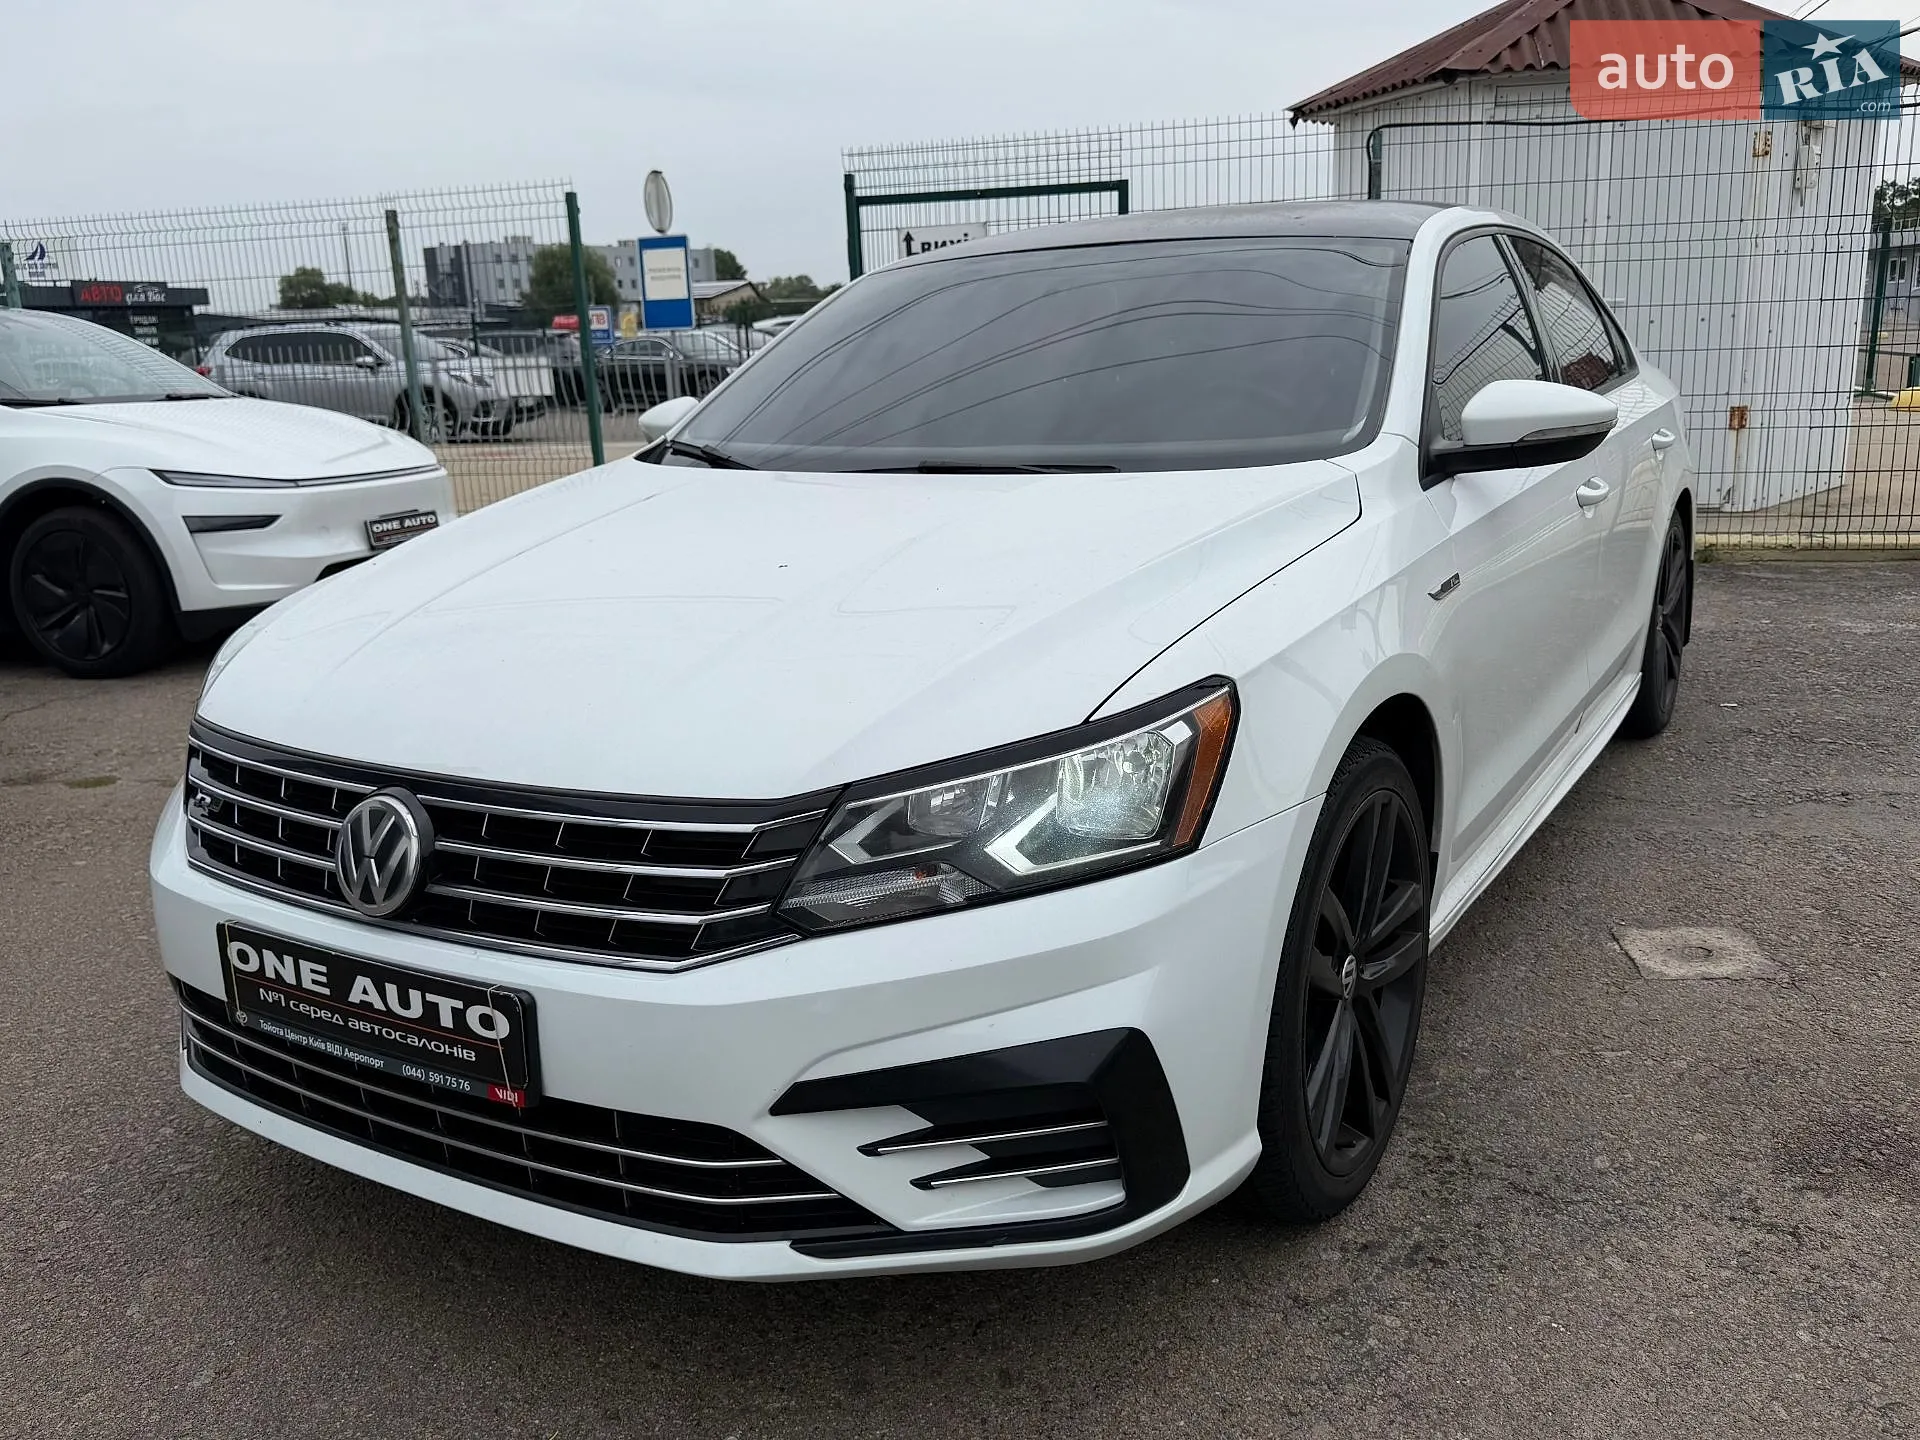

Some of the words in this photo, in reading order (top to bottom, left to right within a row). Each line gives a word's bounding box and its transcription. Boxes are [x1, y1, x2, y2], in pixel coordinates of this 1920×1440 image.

[372, 521, 401, 533] ONE
[404, 515, 436, 528] AUTO
[227, 941, 331, 995] ONE
[348, 975, 510, 1040] AUTO
[258, 1019, 284, 1037] Тойота
[284, 1028, 308, 1045] Центр
[308, 1036, 326, 1050] Київ
[326, 1042, 343, 1056] ВІДІ
[343, 1047, 385, 1069] Аеропорт
[289, 1000, 344, 1026] серед
[347, 1017, 476, 1062] автосалонів
[402, 1064, 426, 1081] (044)
[428, 1071, 444, 1085] 591
[445, 1075, 457, 1089] 75
[458, 1079, 471, 1092] 76
[494, 1087, 518, 1103] VIDI
